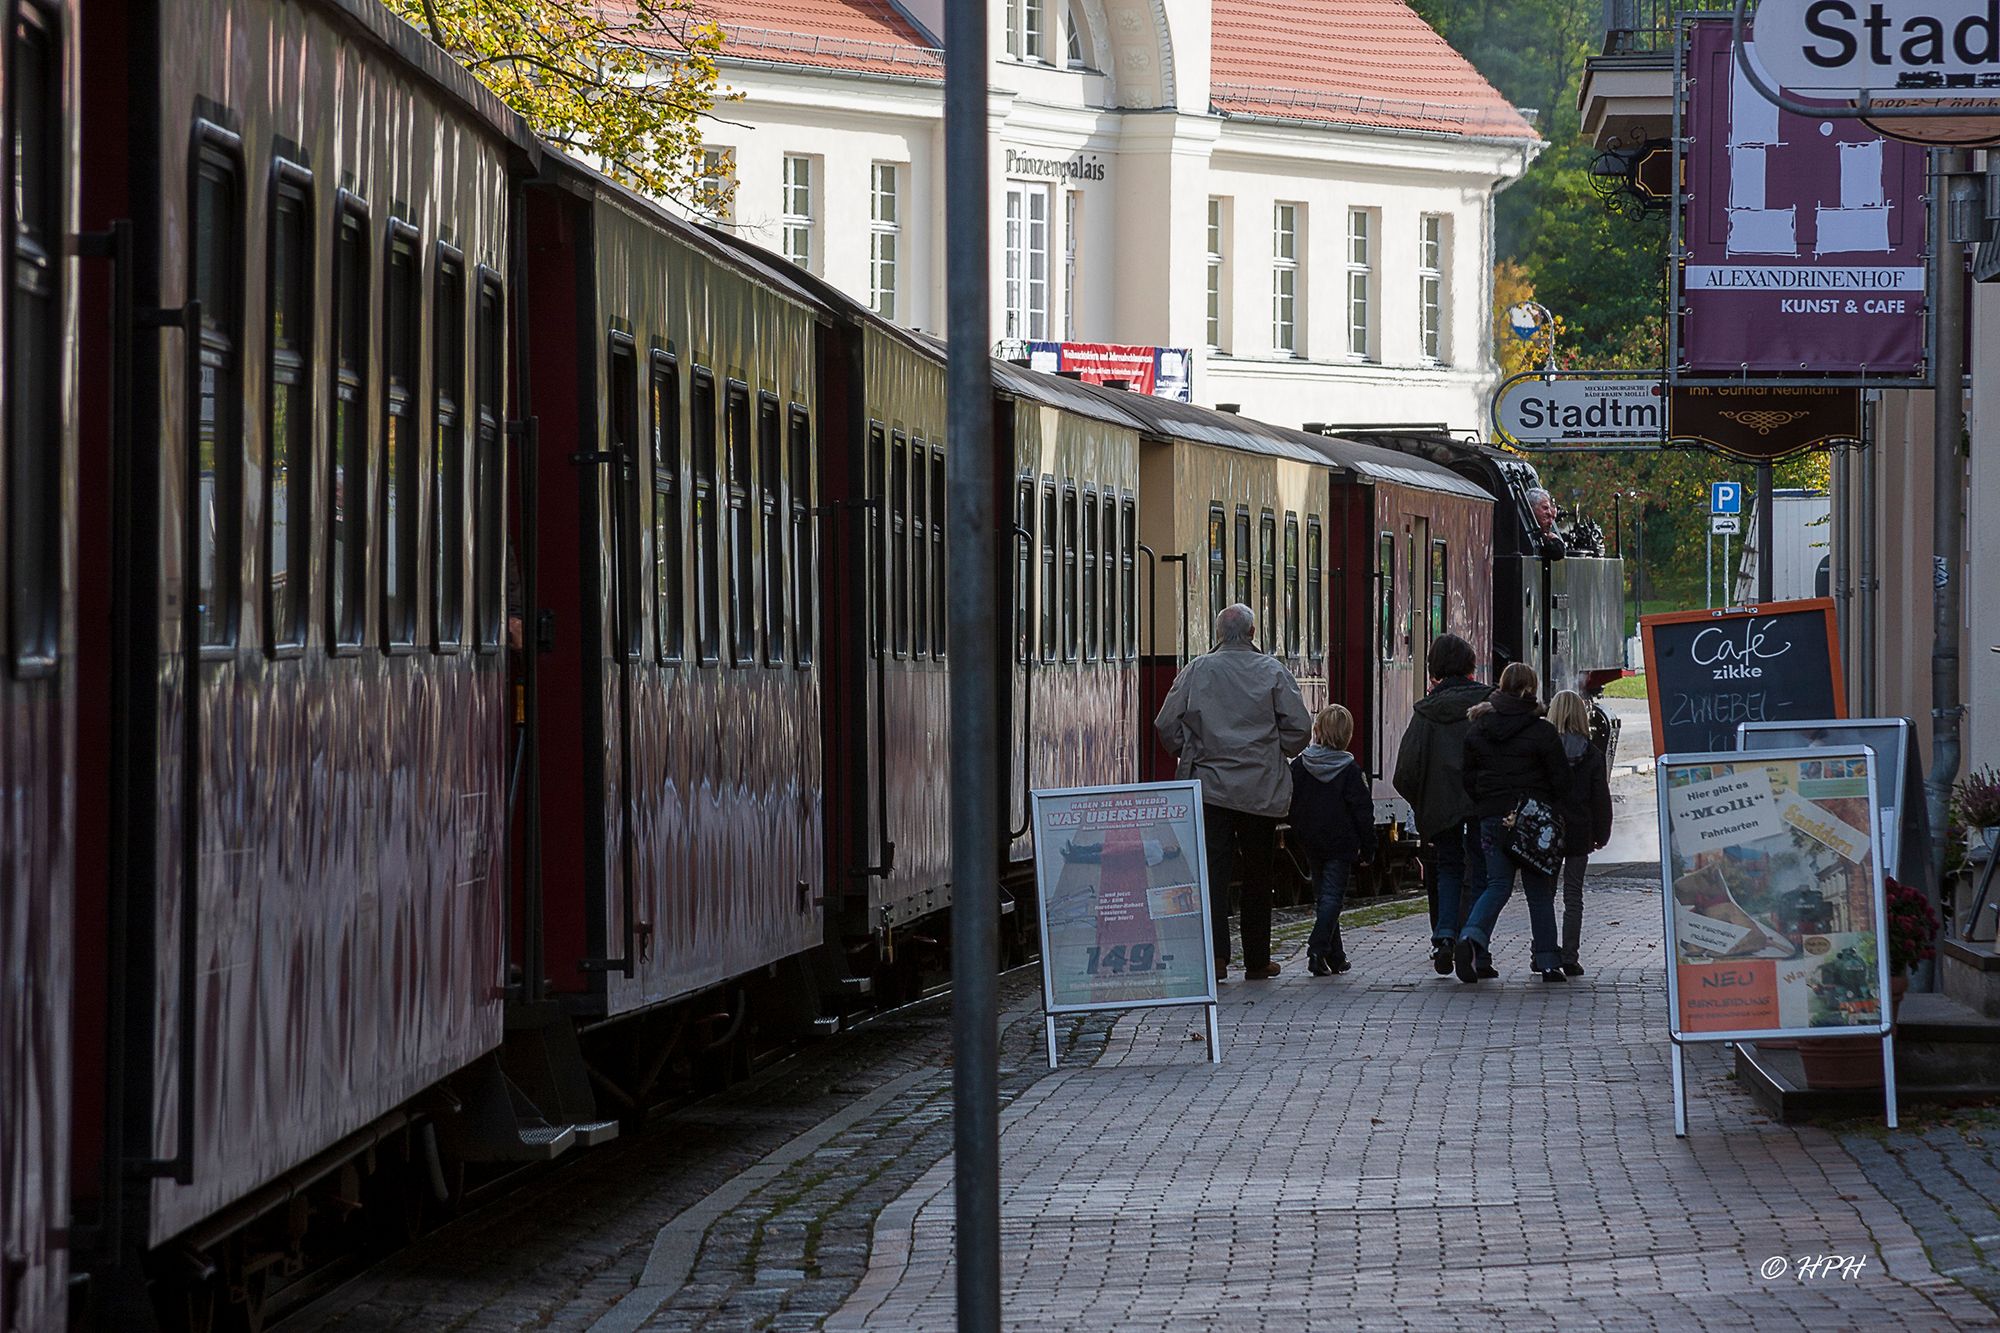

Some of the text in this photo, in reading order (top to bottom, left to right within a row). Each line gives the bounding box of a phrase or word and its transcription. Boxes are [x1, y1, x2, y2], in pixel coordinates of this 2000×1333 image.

[1802, 0, 2000, 68] Stad
[1006, 149, 1105, 185] Prinzenpalais
[1706, 270, 1905, 288] ALEXANDRINENHOF
[1781, 300, 1905, 313] KUNST & CAFE
[1519, 398, 1657, 428] Stadtm
[1718, 486, 1734, 510] P
[1691, 618, 1791, 666] Café
[1713, 664, 1763, 679] zikke
[1136, 797, 1167, 805] WIEDER
[1687, 781, 1749, 801] Hier gibt es
[1048, 805, 1187, 826] WAS ÜBERSEHEN?
[1700, 819, 1759, 839] Fahrkarten
[1702, 971, 1755, 989] NEU
